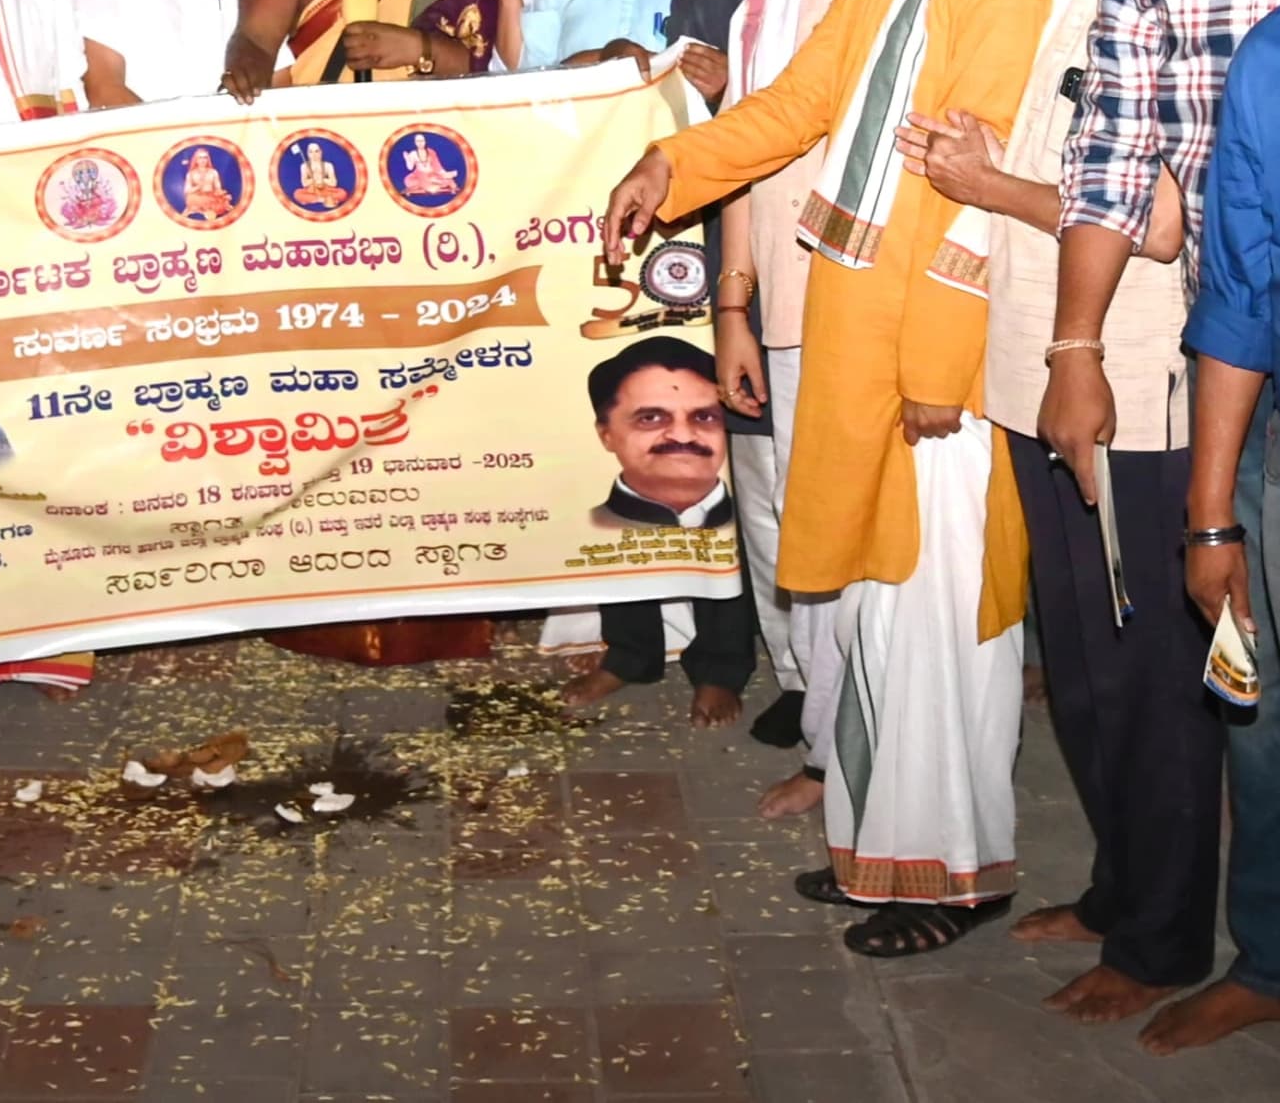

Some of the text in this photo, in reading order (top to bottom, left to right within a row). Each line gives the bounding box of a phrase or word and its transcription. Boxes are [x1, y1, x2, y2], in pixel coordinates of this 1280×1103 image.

[113, 241, 222, 293] ಬ್ರಾಹ್ಮಣ
[241, 228, 402, 271] ಮಹಾಸಭಾ
[423, 222, 496, 270] (ರಿ.),
[12, 323, 127, 359] ಸುವರ್ಣ
[145, 306, 260, 346] ಸಂಭ್ರಮ
[275, 302, 365, 331] 1974
[416, 284, 517, 327] 2024
[26, 340, 533, 420] 11ನೇ ಬ್ರಾಹ್ಮಣ ಮಹಾ ಸಮ್ಮೇಳನ
[45, 501, 108, 516] ದಿನಾಂಕ
[132, 492, 188, 514] ಜನವರಿ
[197, 485, 221, 505] 18
[231, 480, 293, 501] ಶನಿವಾರ
[350, 457, 373, 475] 19
[383, 454, 462, 475] ಭಾನುವಾರ
[44, 546, 96, 571] ಮೈಸೂರು
[102, 544, 131, 555] ನಗರ
[137, 540, 174, 554] ಹಾಗೂ
[319, 517, 348, 537] ಮತ್ತು
[353, 513, 383, 530] ಇತರೆ
[389, 513, 415, 531] ಎಲ್ಲಾ
[421, 510, 458, 532] ಬ್ರಾಹ್ಮಣ
[464, 508, 492, 524] ಸಂಘ
[105, 541, 508, 595] ಸರ್ವರಿಗೂ ಆದರದ ಸ್ವಾಗತ
